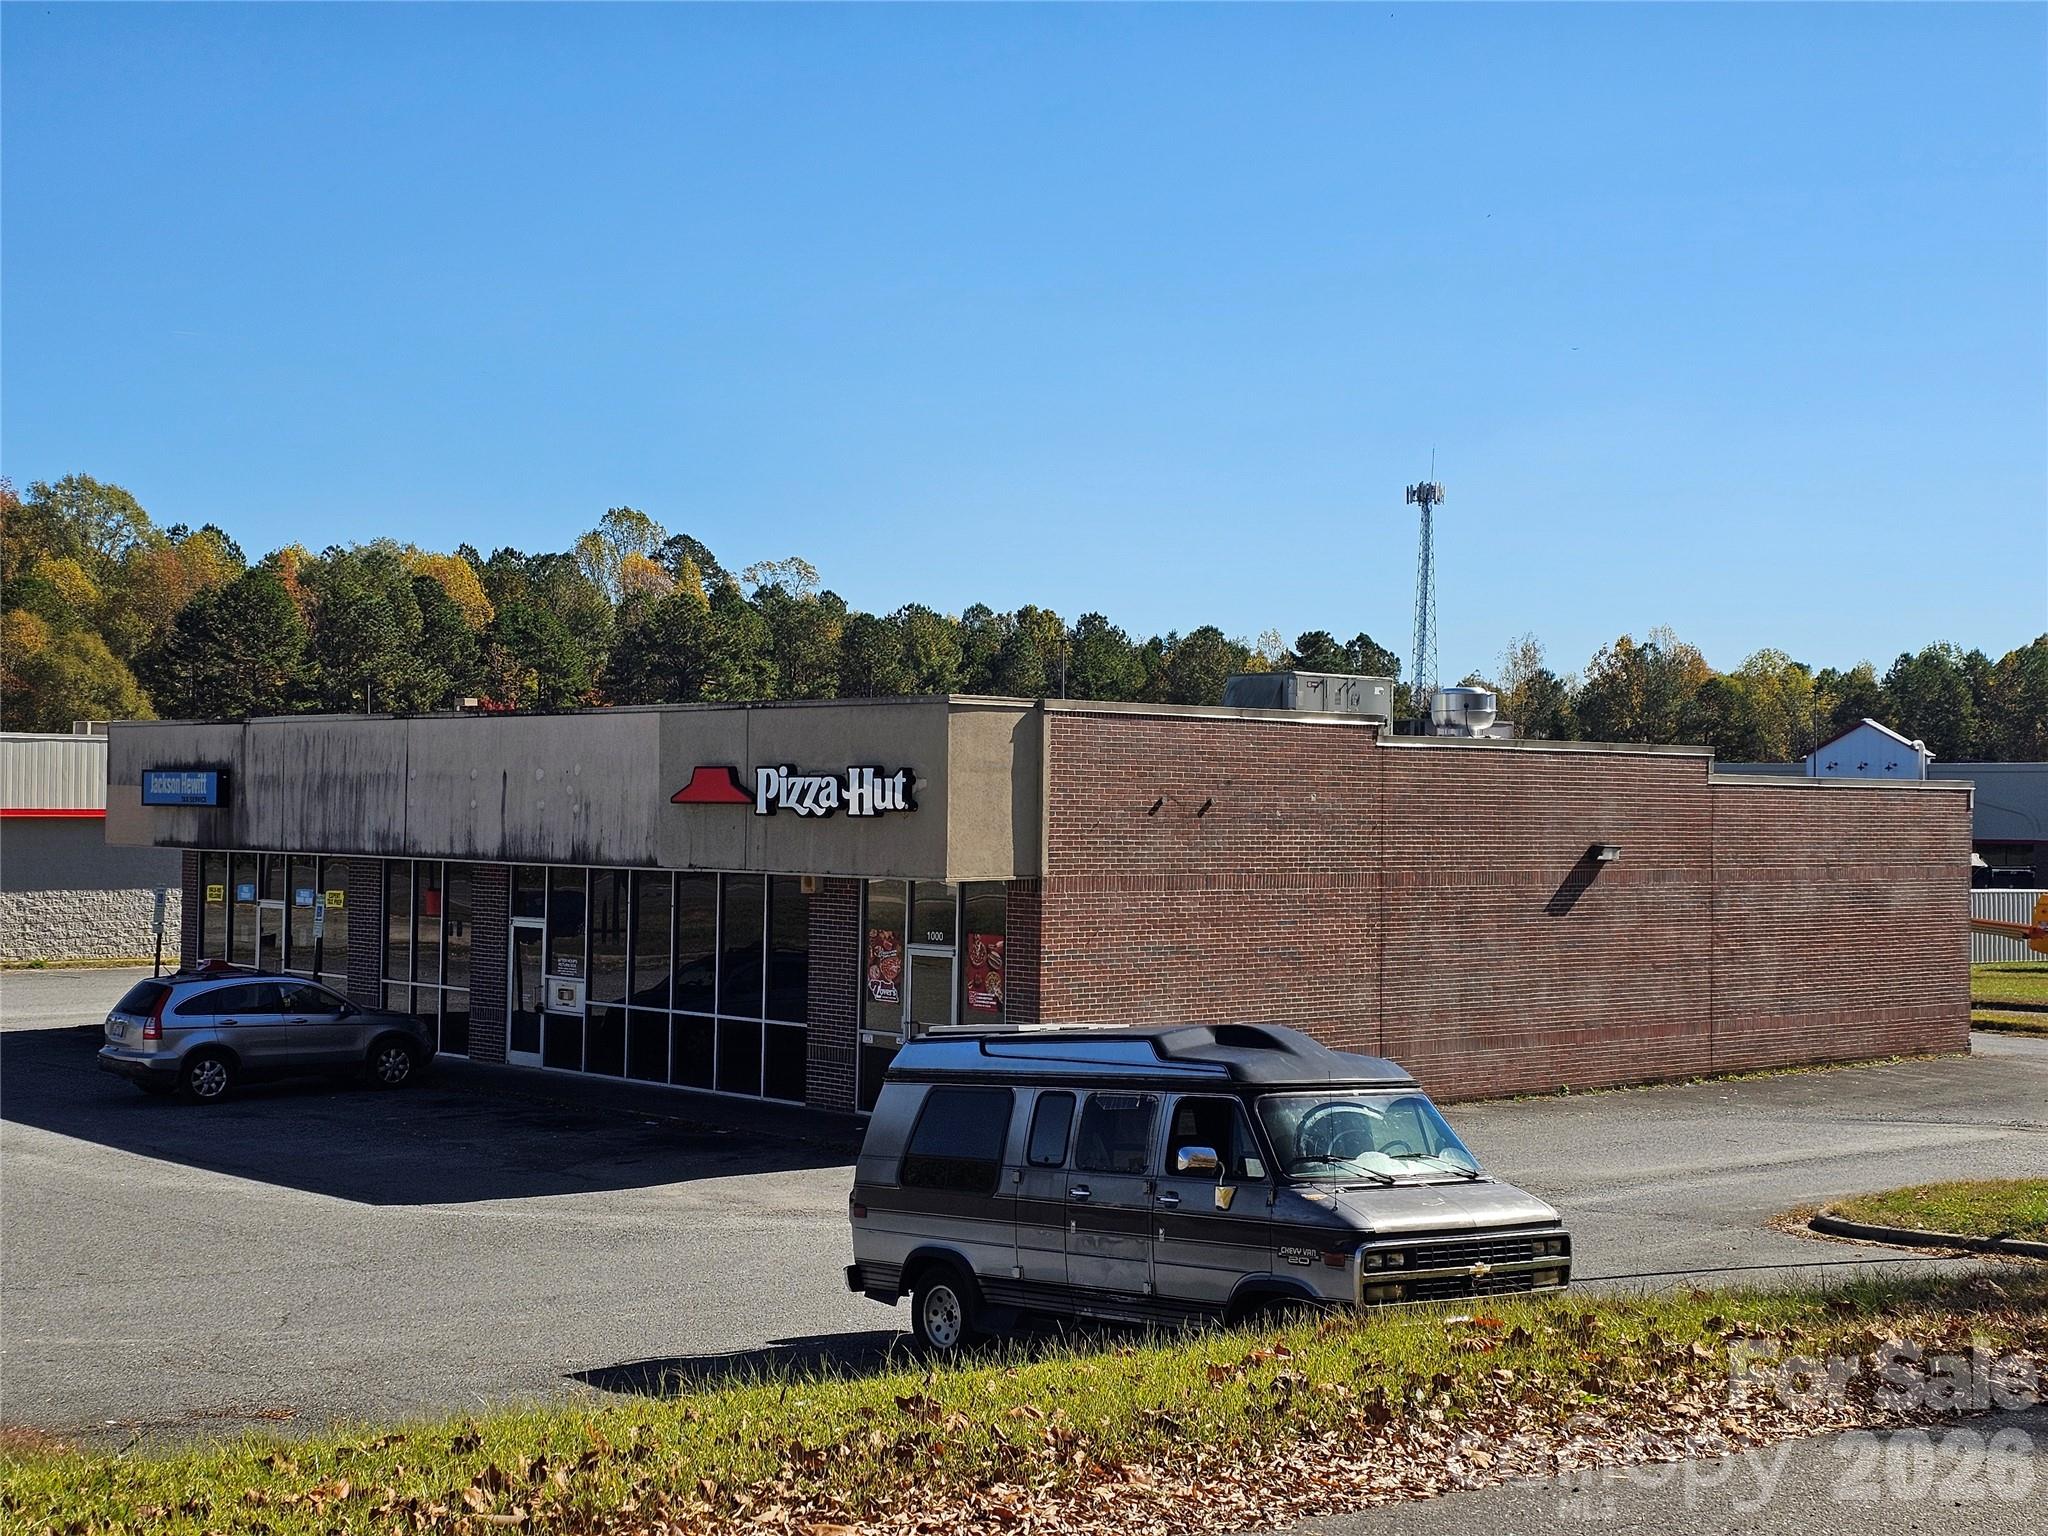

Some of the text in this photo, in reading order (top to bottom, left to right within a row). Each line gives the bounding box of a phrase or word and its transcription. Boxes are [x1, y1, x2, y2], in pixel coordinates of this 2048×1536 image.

[151, 772, 207, 794] Jackson Hewitt
[756, 766, 906, 815] Pizza Hut
[927, 931, 944, 941] 1000
[1280, 1246, 1317, 1257] CHEVY VAN
[1288, 1256, 1310, 1265] 20
